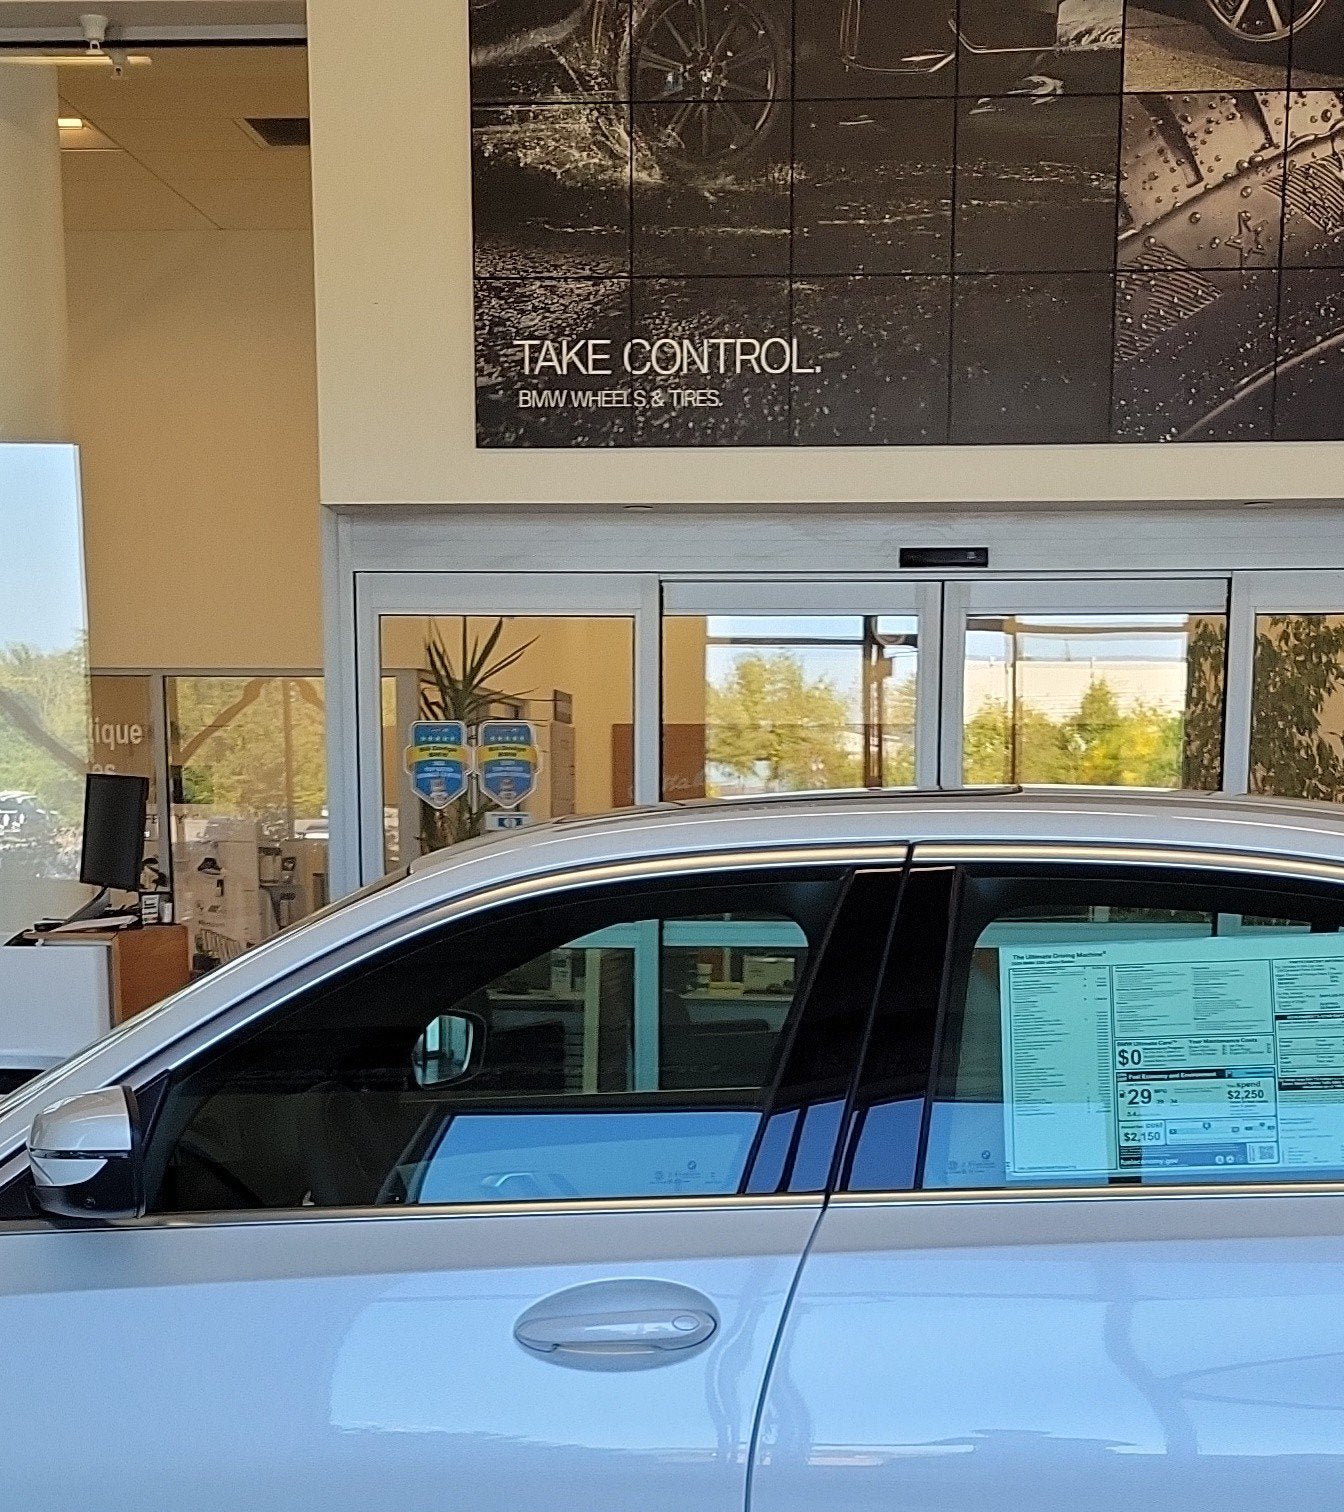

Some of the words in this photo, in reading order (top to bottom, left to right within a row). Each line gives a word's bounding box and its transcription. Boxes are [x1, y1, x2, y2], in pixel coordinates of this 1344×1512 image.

[513, 340, 612, 375] TAKE
[623, 338, 823, 375] CONTROL.
[518, 390, 569, 408] BMW
[570, 390, 646, 408] WHEELS
[650, 390, 665, 408] &
[668, 390, 724, 408] TIRES.
[1118, 1049, 1142, 1067] $0
[1236, 1081, 1262, 1089] spend
[1127, 1088, 1152, 1105] 29
[1227, 1089, 1265, 1101] $2,250
[1124, 1131, 1161, 1143] $2,150
